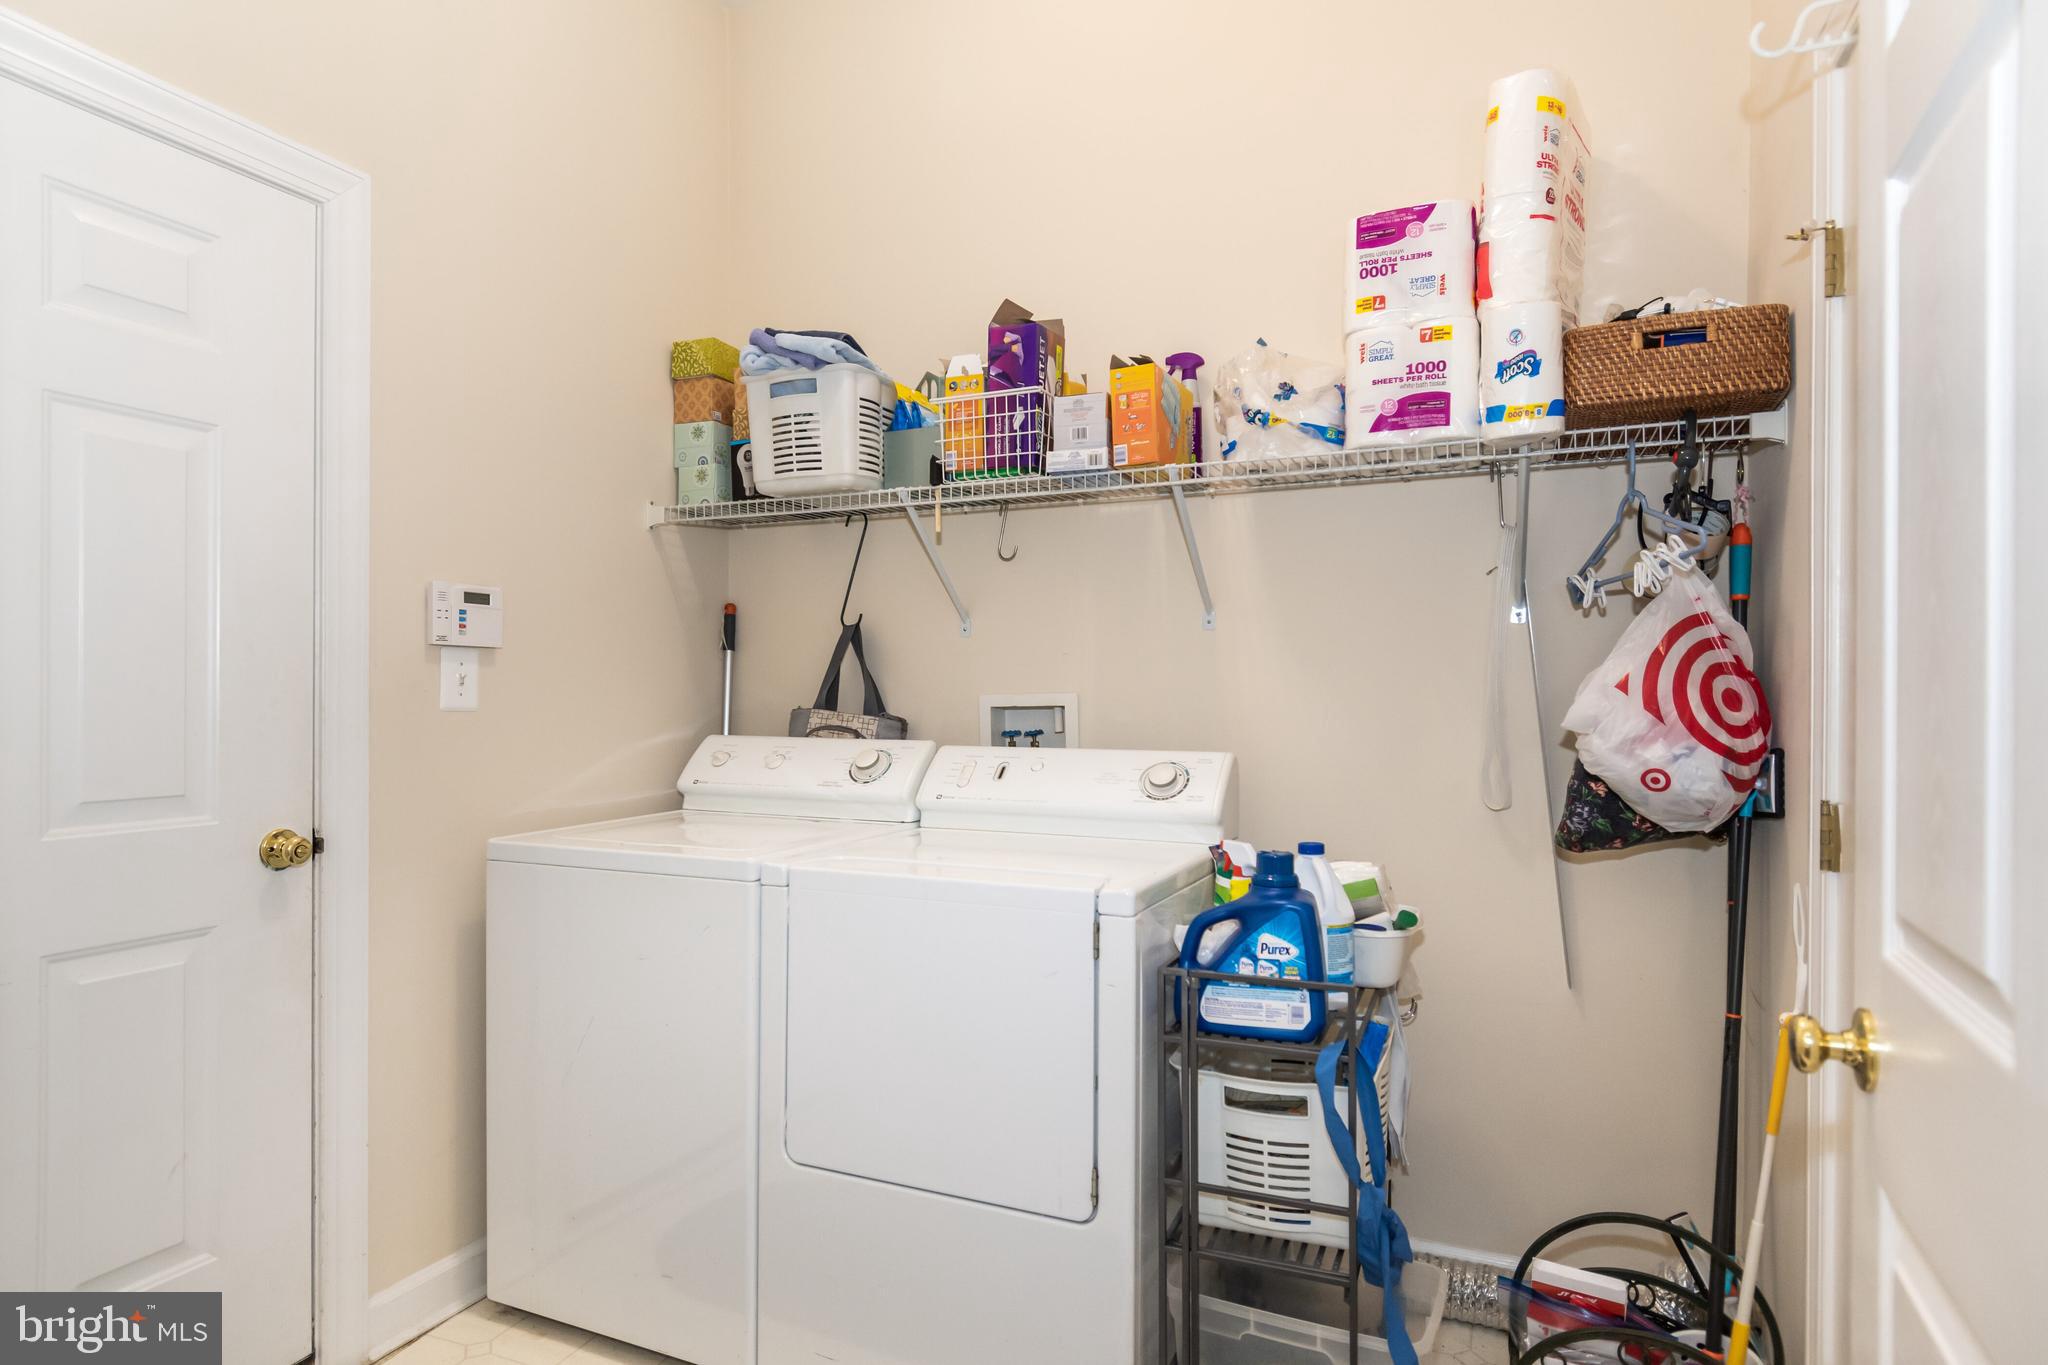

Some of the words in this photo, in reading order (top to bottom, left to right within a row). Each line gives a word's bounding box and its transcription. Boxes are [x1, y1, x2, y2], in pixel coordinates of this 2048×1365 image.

[1381, 256, 1398, 264] PER
[1400, 251, 1433, 262] SHEETS
[1359, 258, 1379, 268] ROLL
[1360, 263, 1398, 280] 1000
[1411, 274, 1437, 284] GREAT
[1410, 282, 1436, 291] SIMPLY
[1368, 347, 1394, 356] SIMPLY
[1368, 354, 1394, 363] GREAT
[1405, 360, 1447, 375] 1000
[1502, 357, 1534, 384] Scott
[1371, 376, 1404, 386] SHEETS
[1260, 942, 1291, 956] Purex
